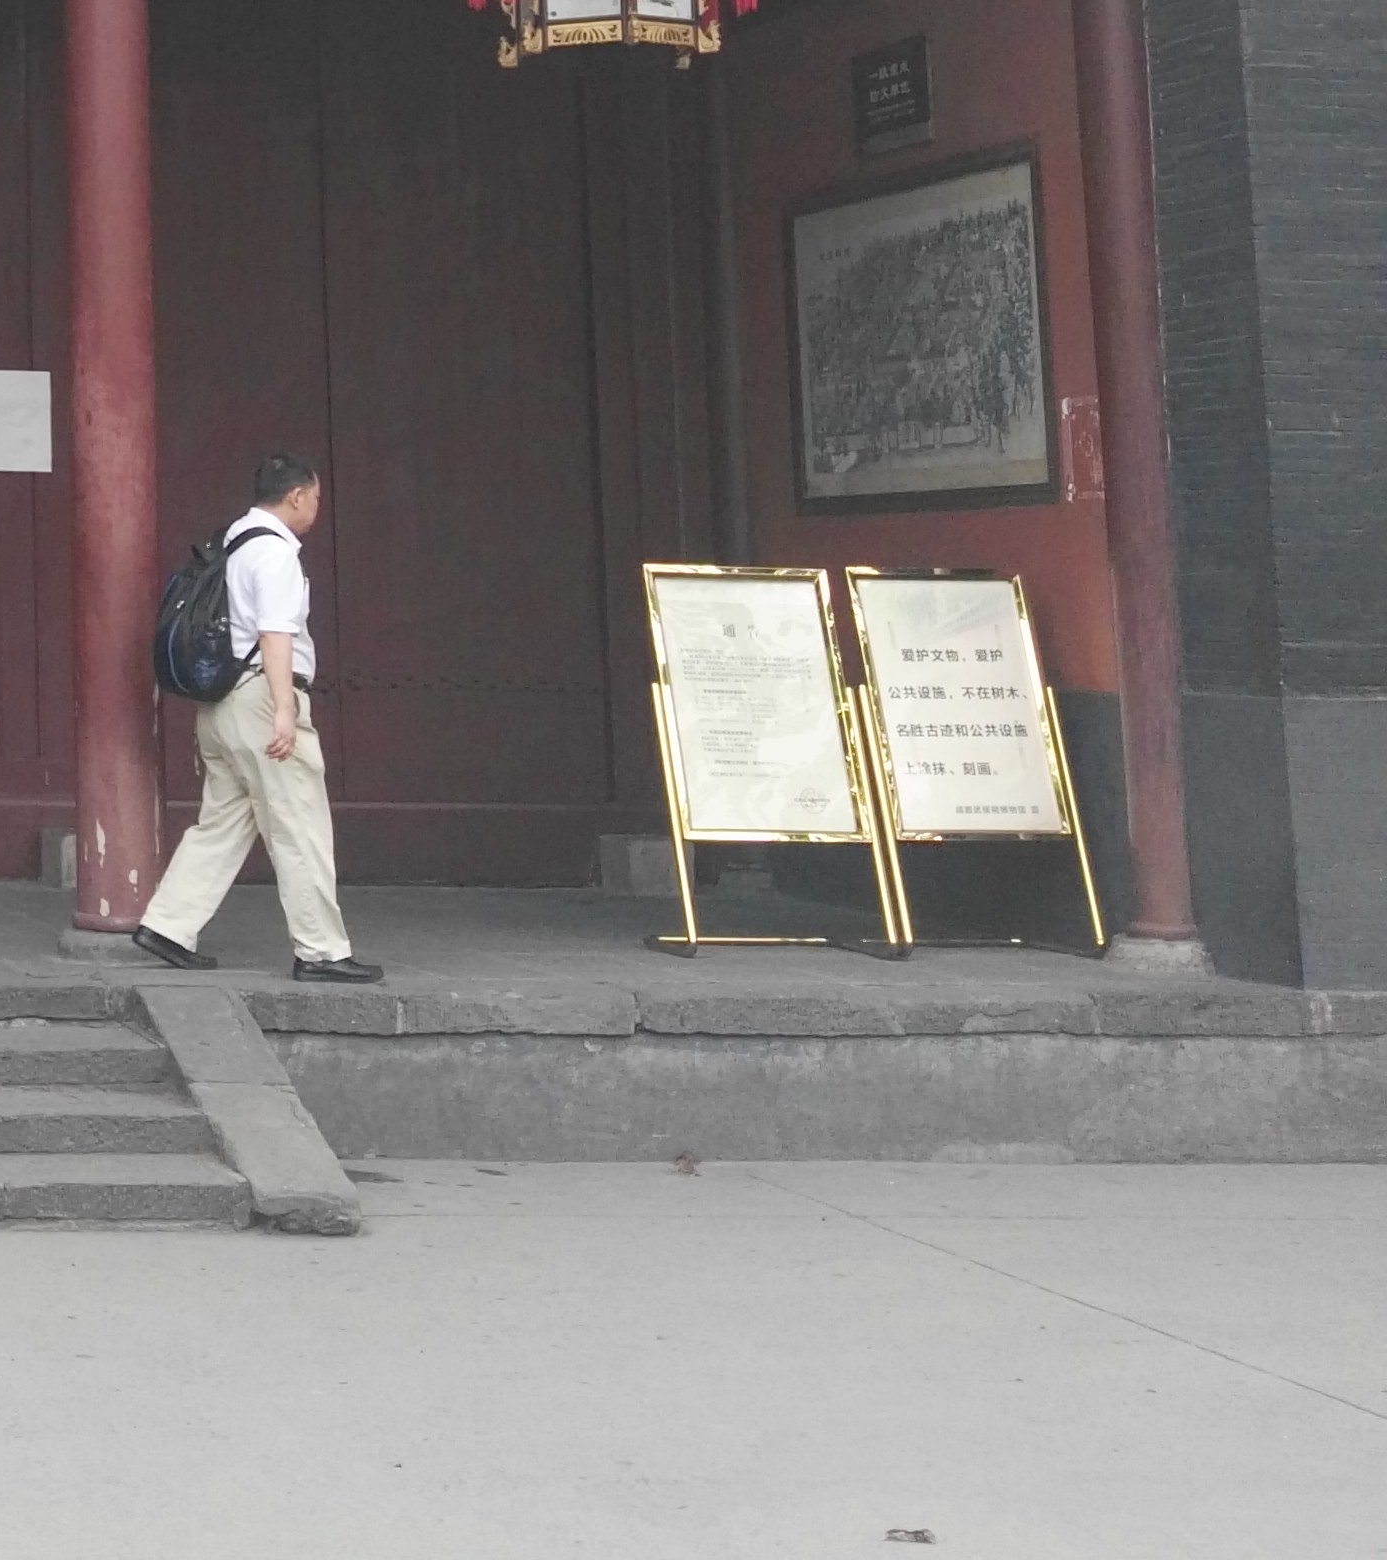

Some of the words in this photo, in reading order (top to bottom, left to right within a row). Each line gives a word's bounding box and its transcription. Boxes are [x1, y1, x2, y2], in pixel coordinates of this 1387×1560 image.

[896, 723, 1029, 738] 名胜古迹和公共设施
